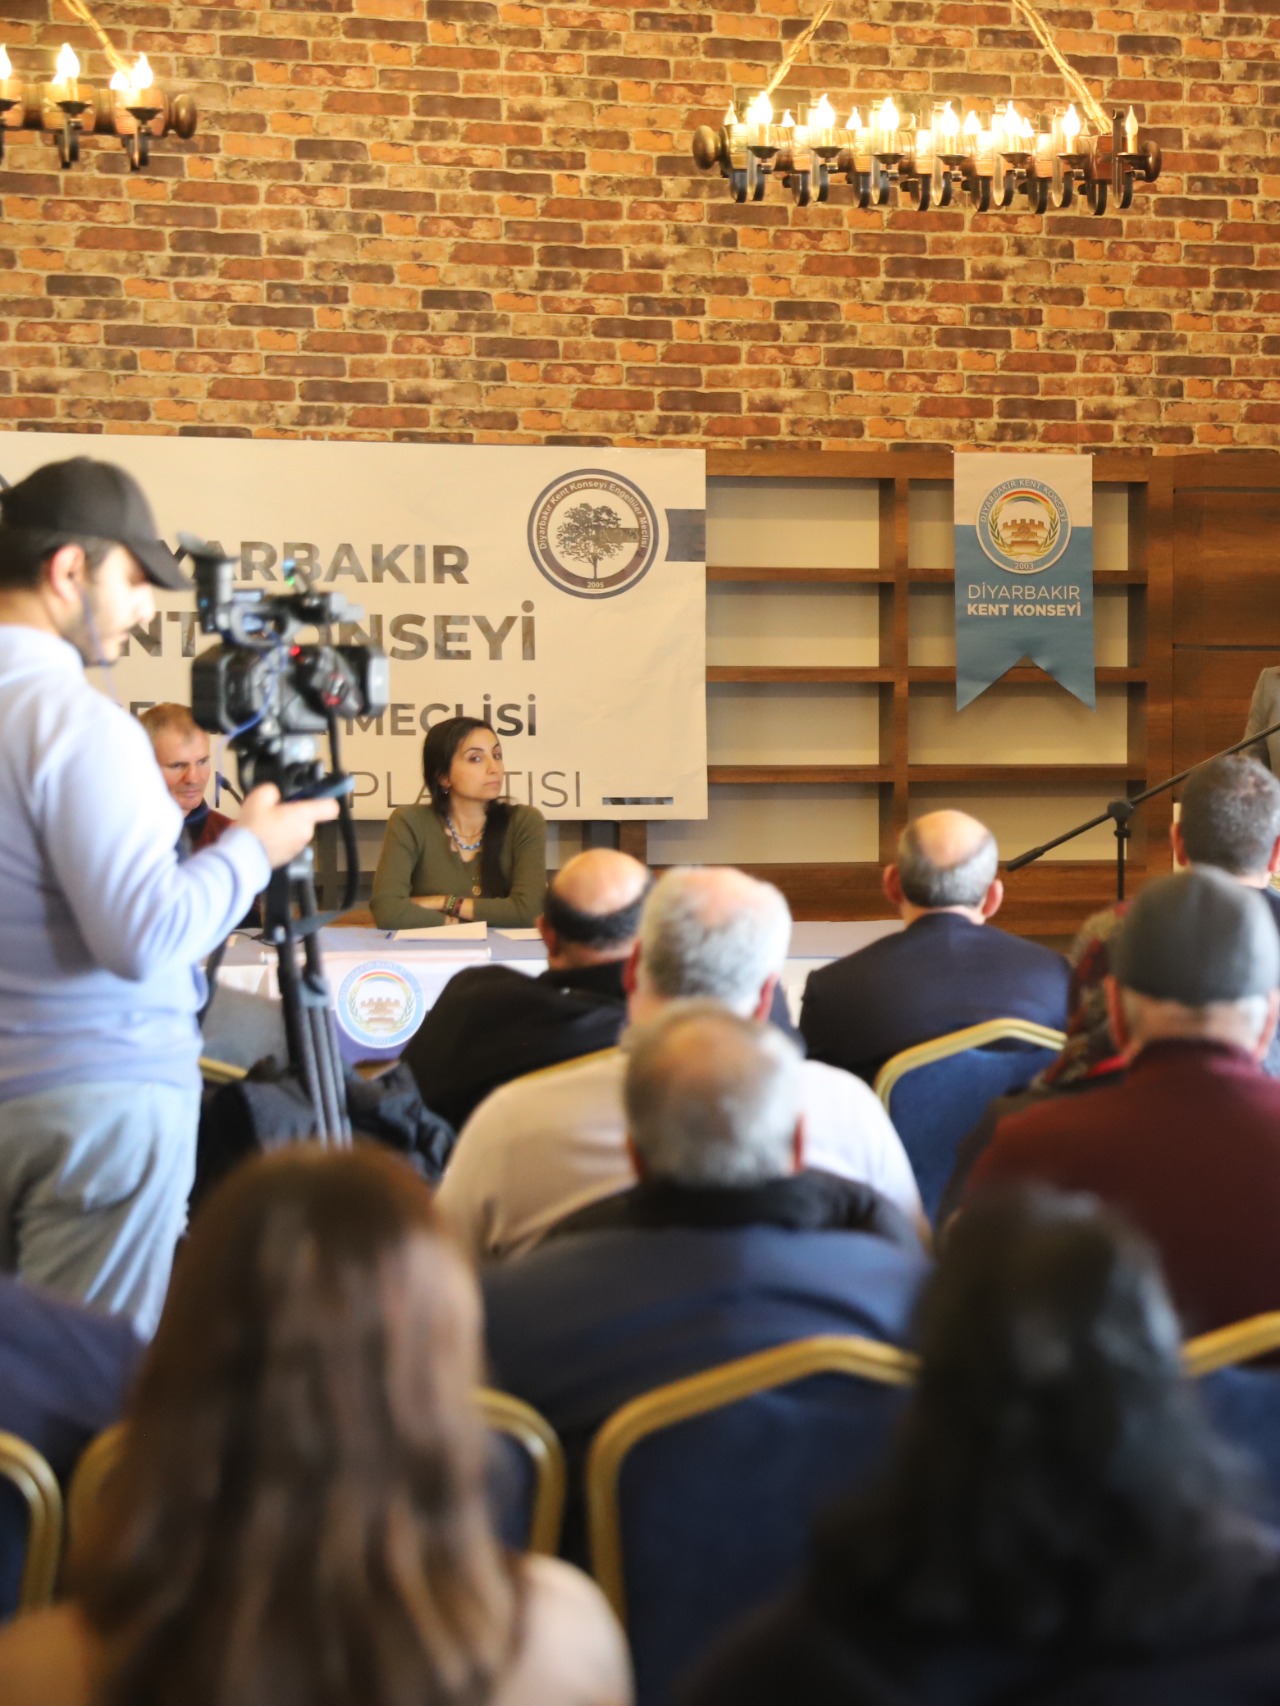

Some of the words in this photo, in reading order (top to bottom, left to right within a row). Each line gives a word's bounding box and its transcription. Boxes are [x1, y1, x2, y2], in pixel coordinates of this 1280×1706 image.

[1019, 479, 1042, 490] KENT
[549, 487, 570, 505] Kent
[569, 480, 608, 490] Konseyi
[1014, 562, 1034, 570] 2003
[586, 581, 604, 589] 2005
[968, 582, 1080, 600] DİYARBAKIR
[967, 603, 1009, 616] KENT
[1013, 602, 1081, 617] KONSEYİ
[345, 693, 537, 737] MECİSİ
